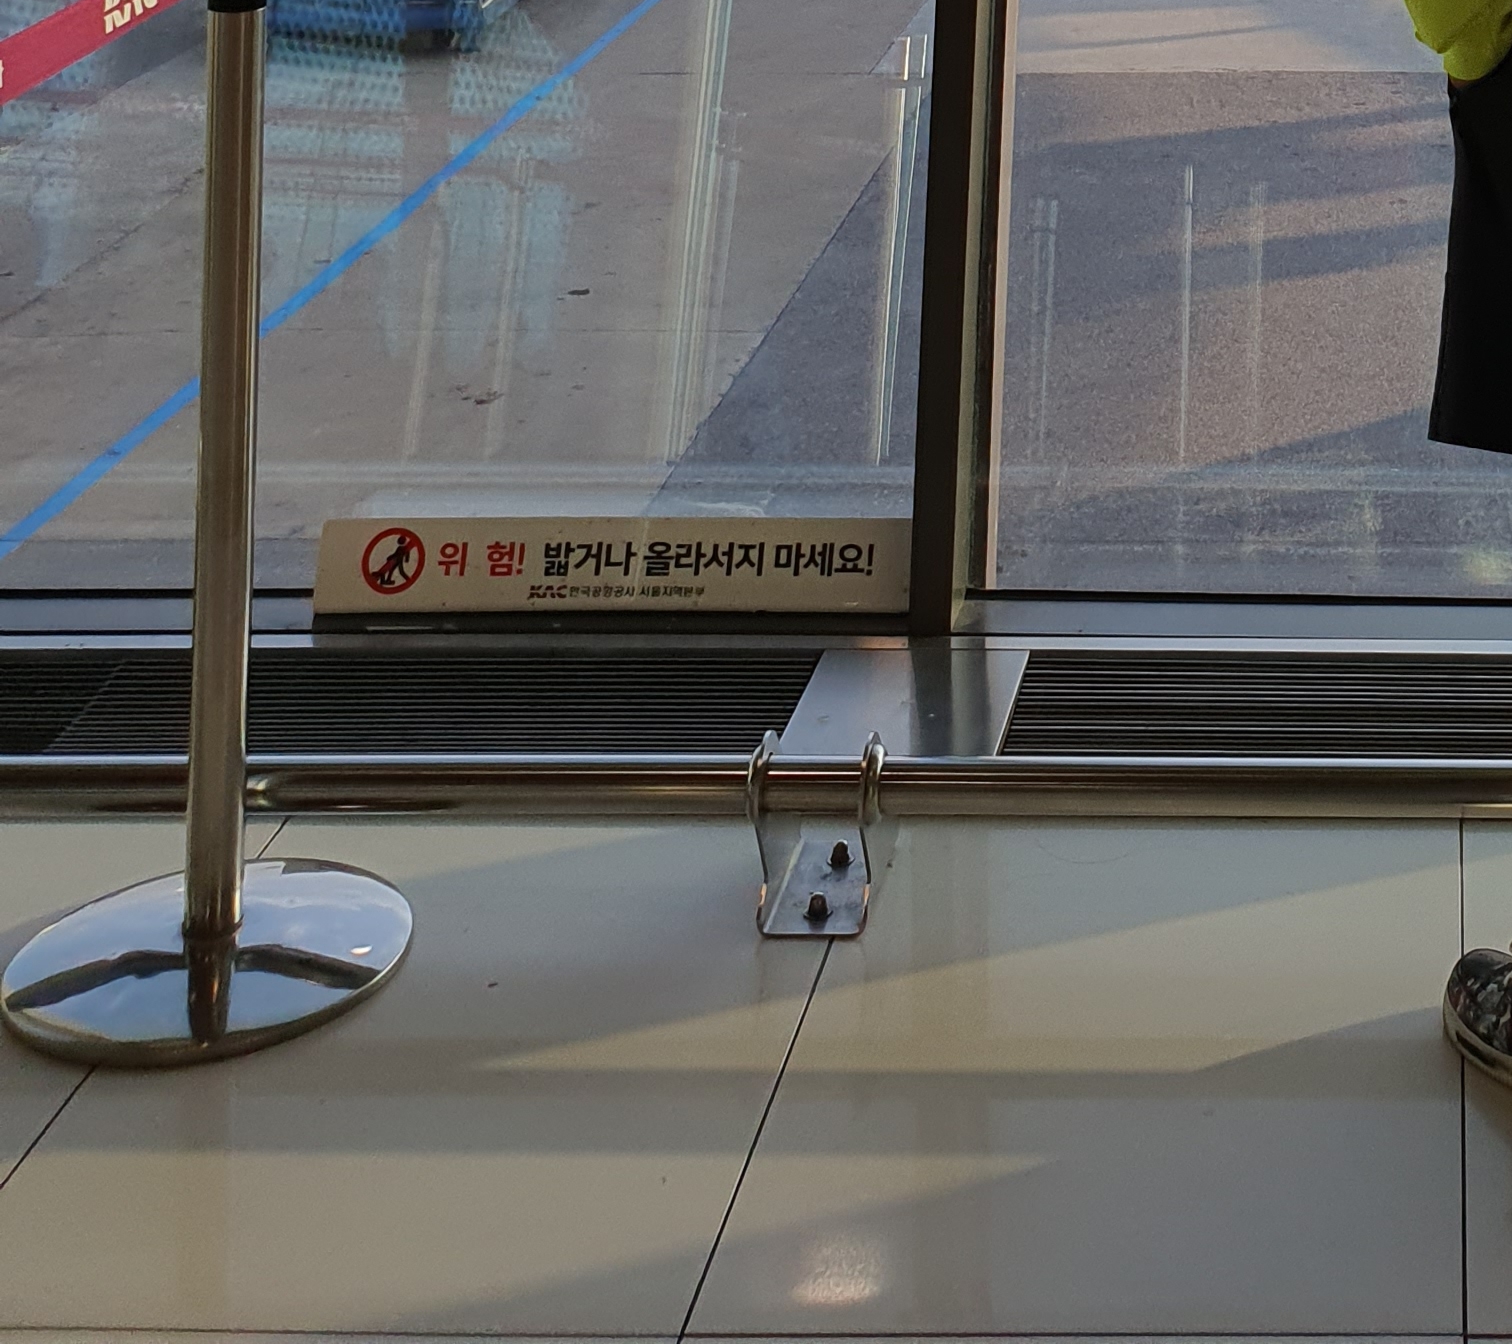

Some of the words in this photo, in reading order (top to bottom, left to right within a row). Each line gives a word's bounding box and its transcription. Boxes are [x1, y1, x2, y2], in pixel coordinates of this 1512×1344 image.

[437, 541, 468, 577] 위
[486, 541, 526, 577] 험!
[543, 541, 637, 577] 밟거나
[643, 541, 765, 577] 올라서지
[773, 541, 875, 577] 마세요!
